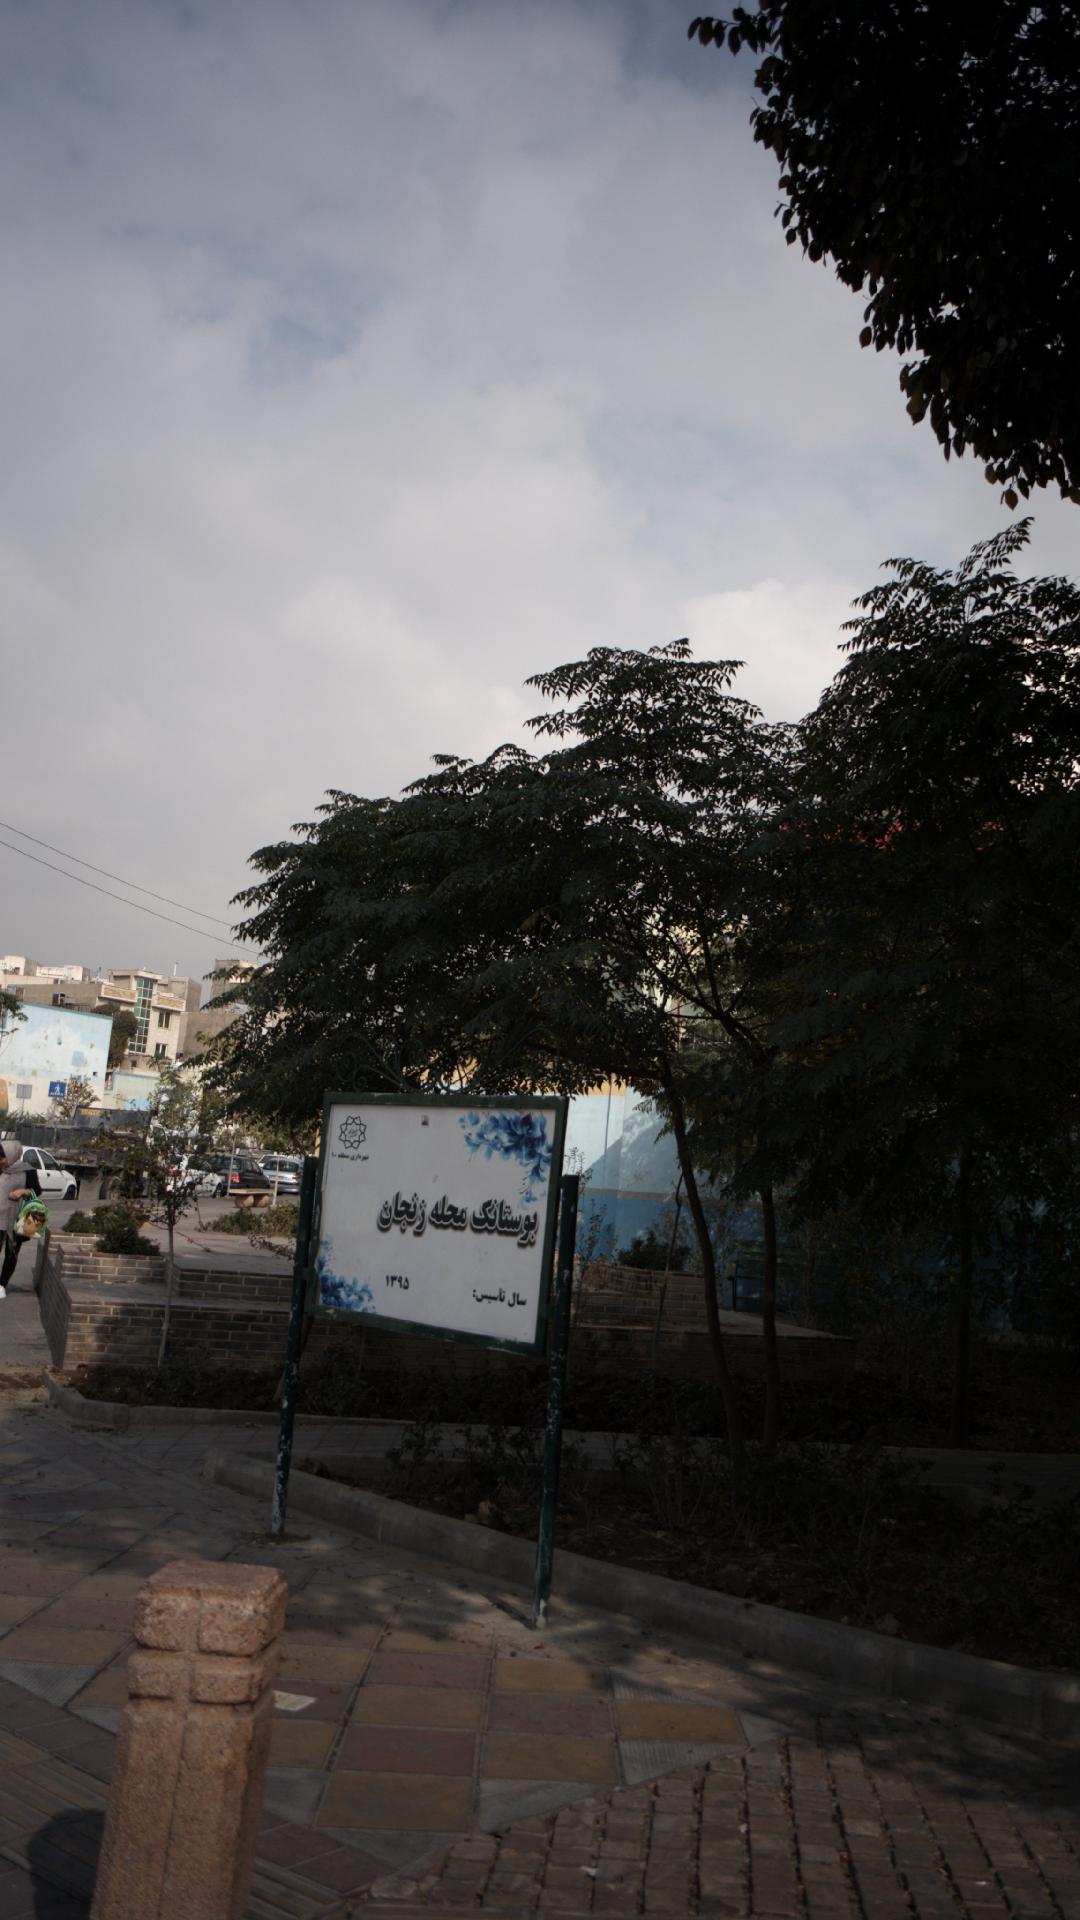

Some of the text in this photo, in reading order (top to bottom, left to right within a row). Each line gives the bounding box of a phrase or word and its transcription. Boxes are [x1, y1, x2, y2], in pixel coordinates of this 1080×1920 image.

[378, 1192, 538, 1246] بوستانک محله زنجان
[386, 1275, 409, 1289] ۱۳۹۵
[508, 1292, 527, 1307] سال
